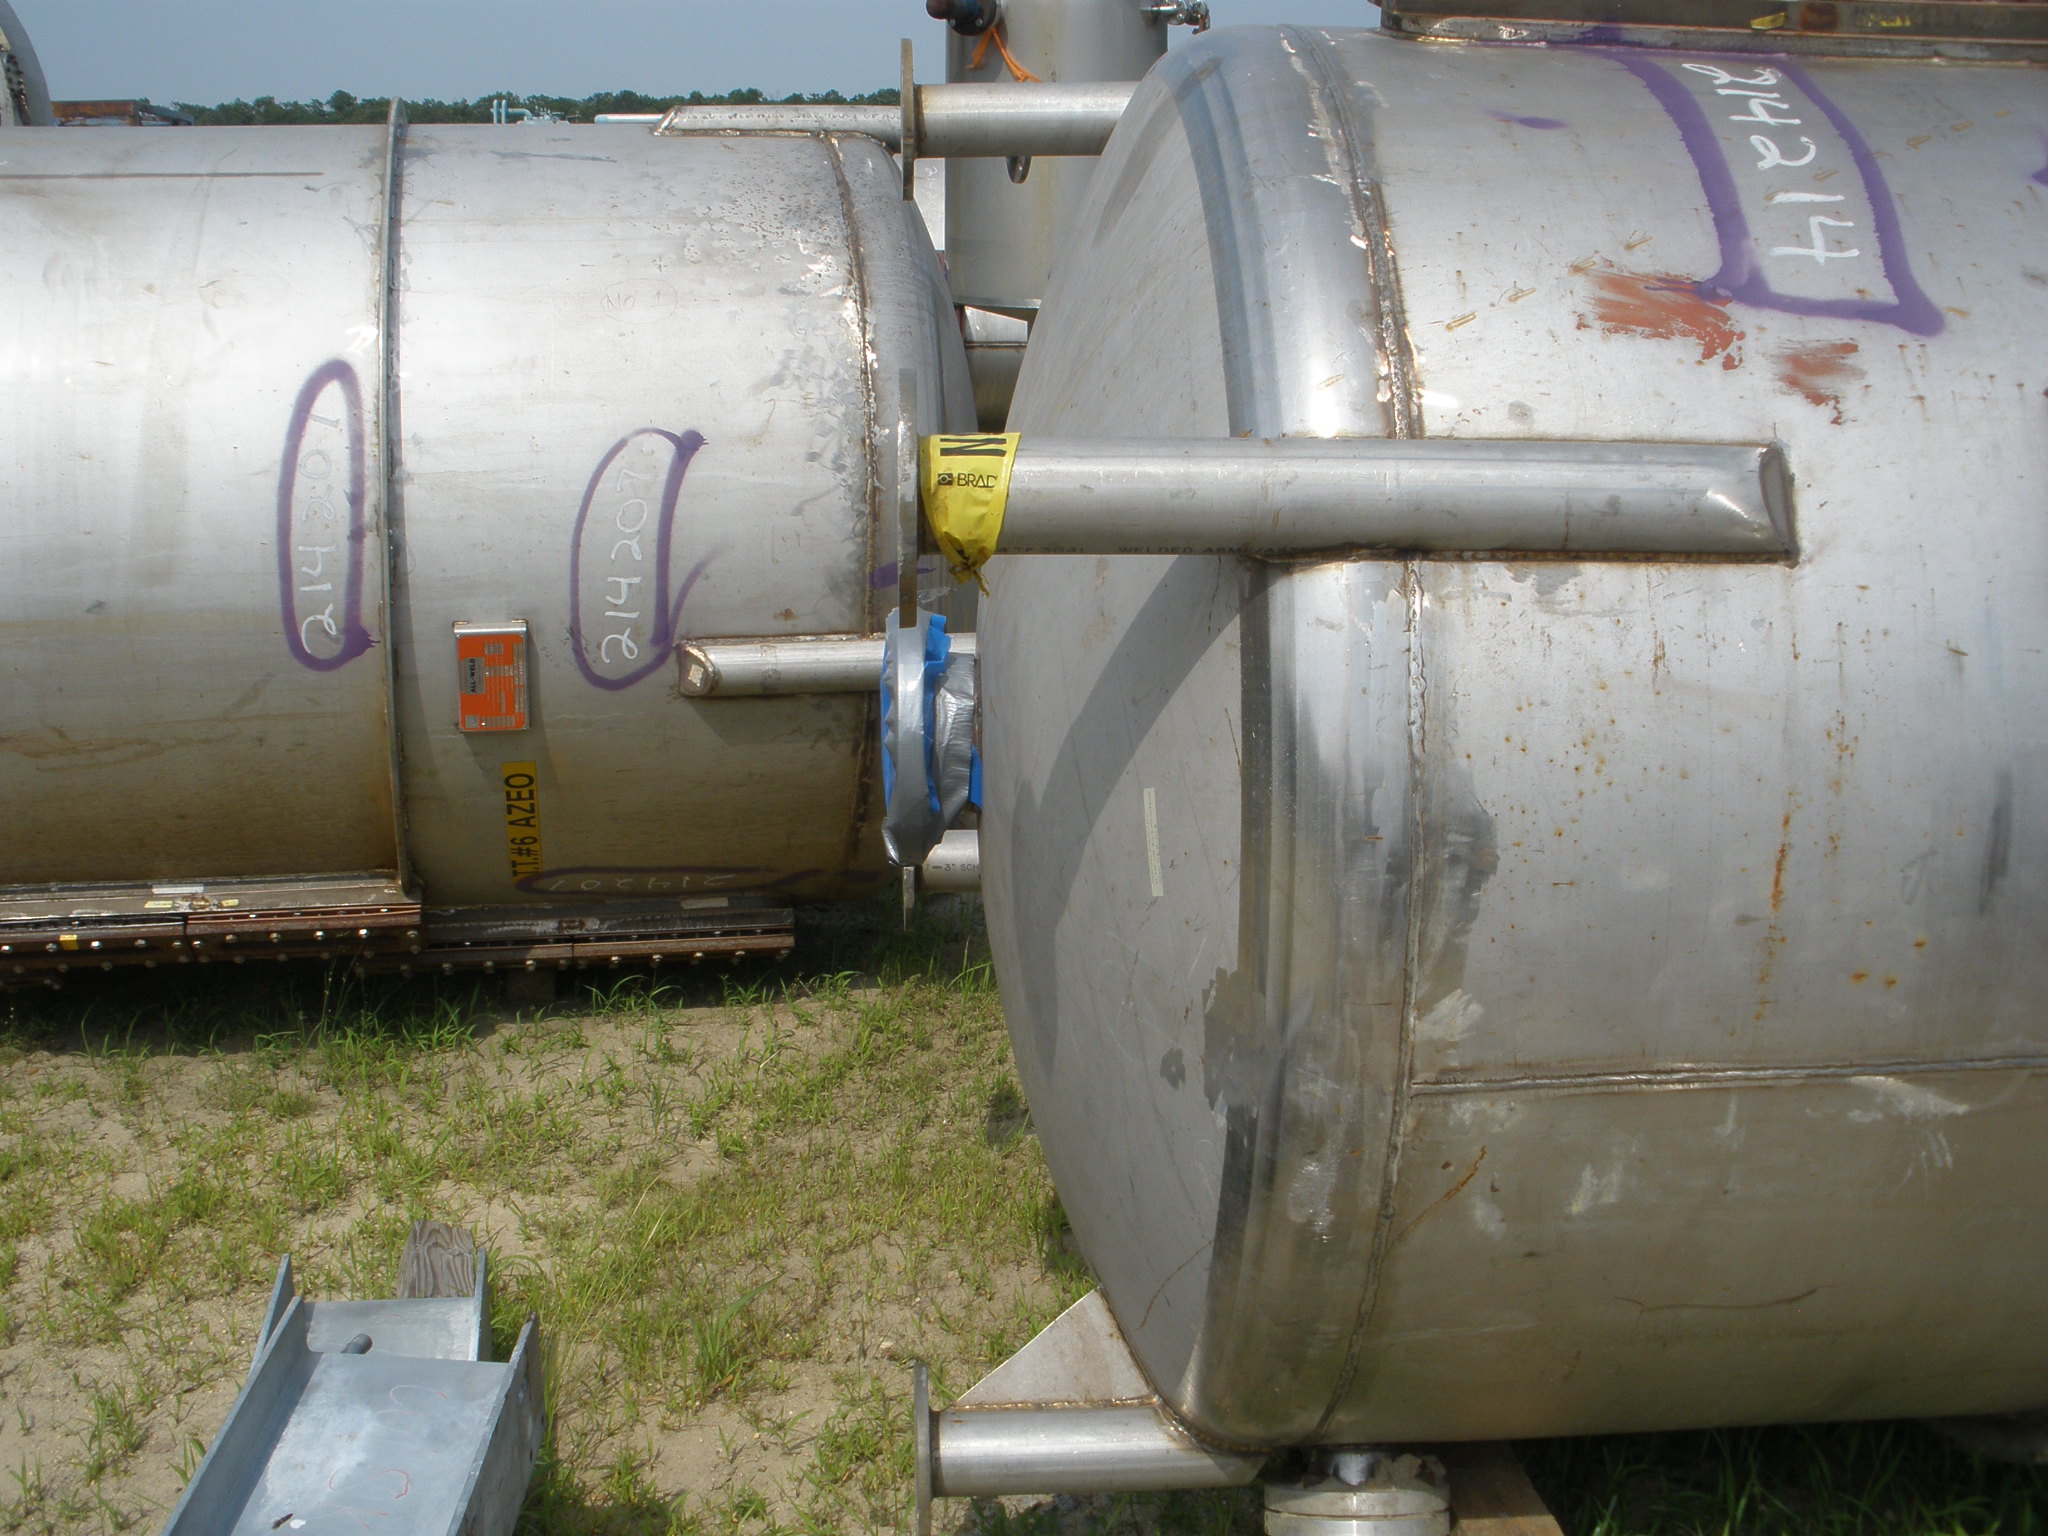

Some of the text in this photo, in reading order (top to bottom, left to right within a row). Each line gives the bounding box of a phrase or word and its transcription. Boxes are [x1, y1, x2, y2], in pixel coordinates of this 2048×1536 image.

[1682, 63, 1860, 266] 214214
[601, 468, 650, 664] 214207
[504, 773, 537, 828] AZEO
